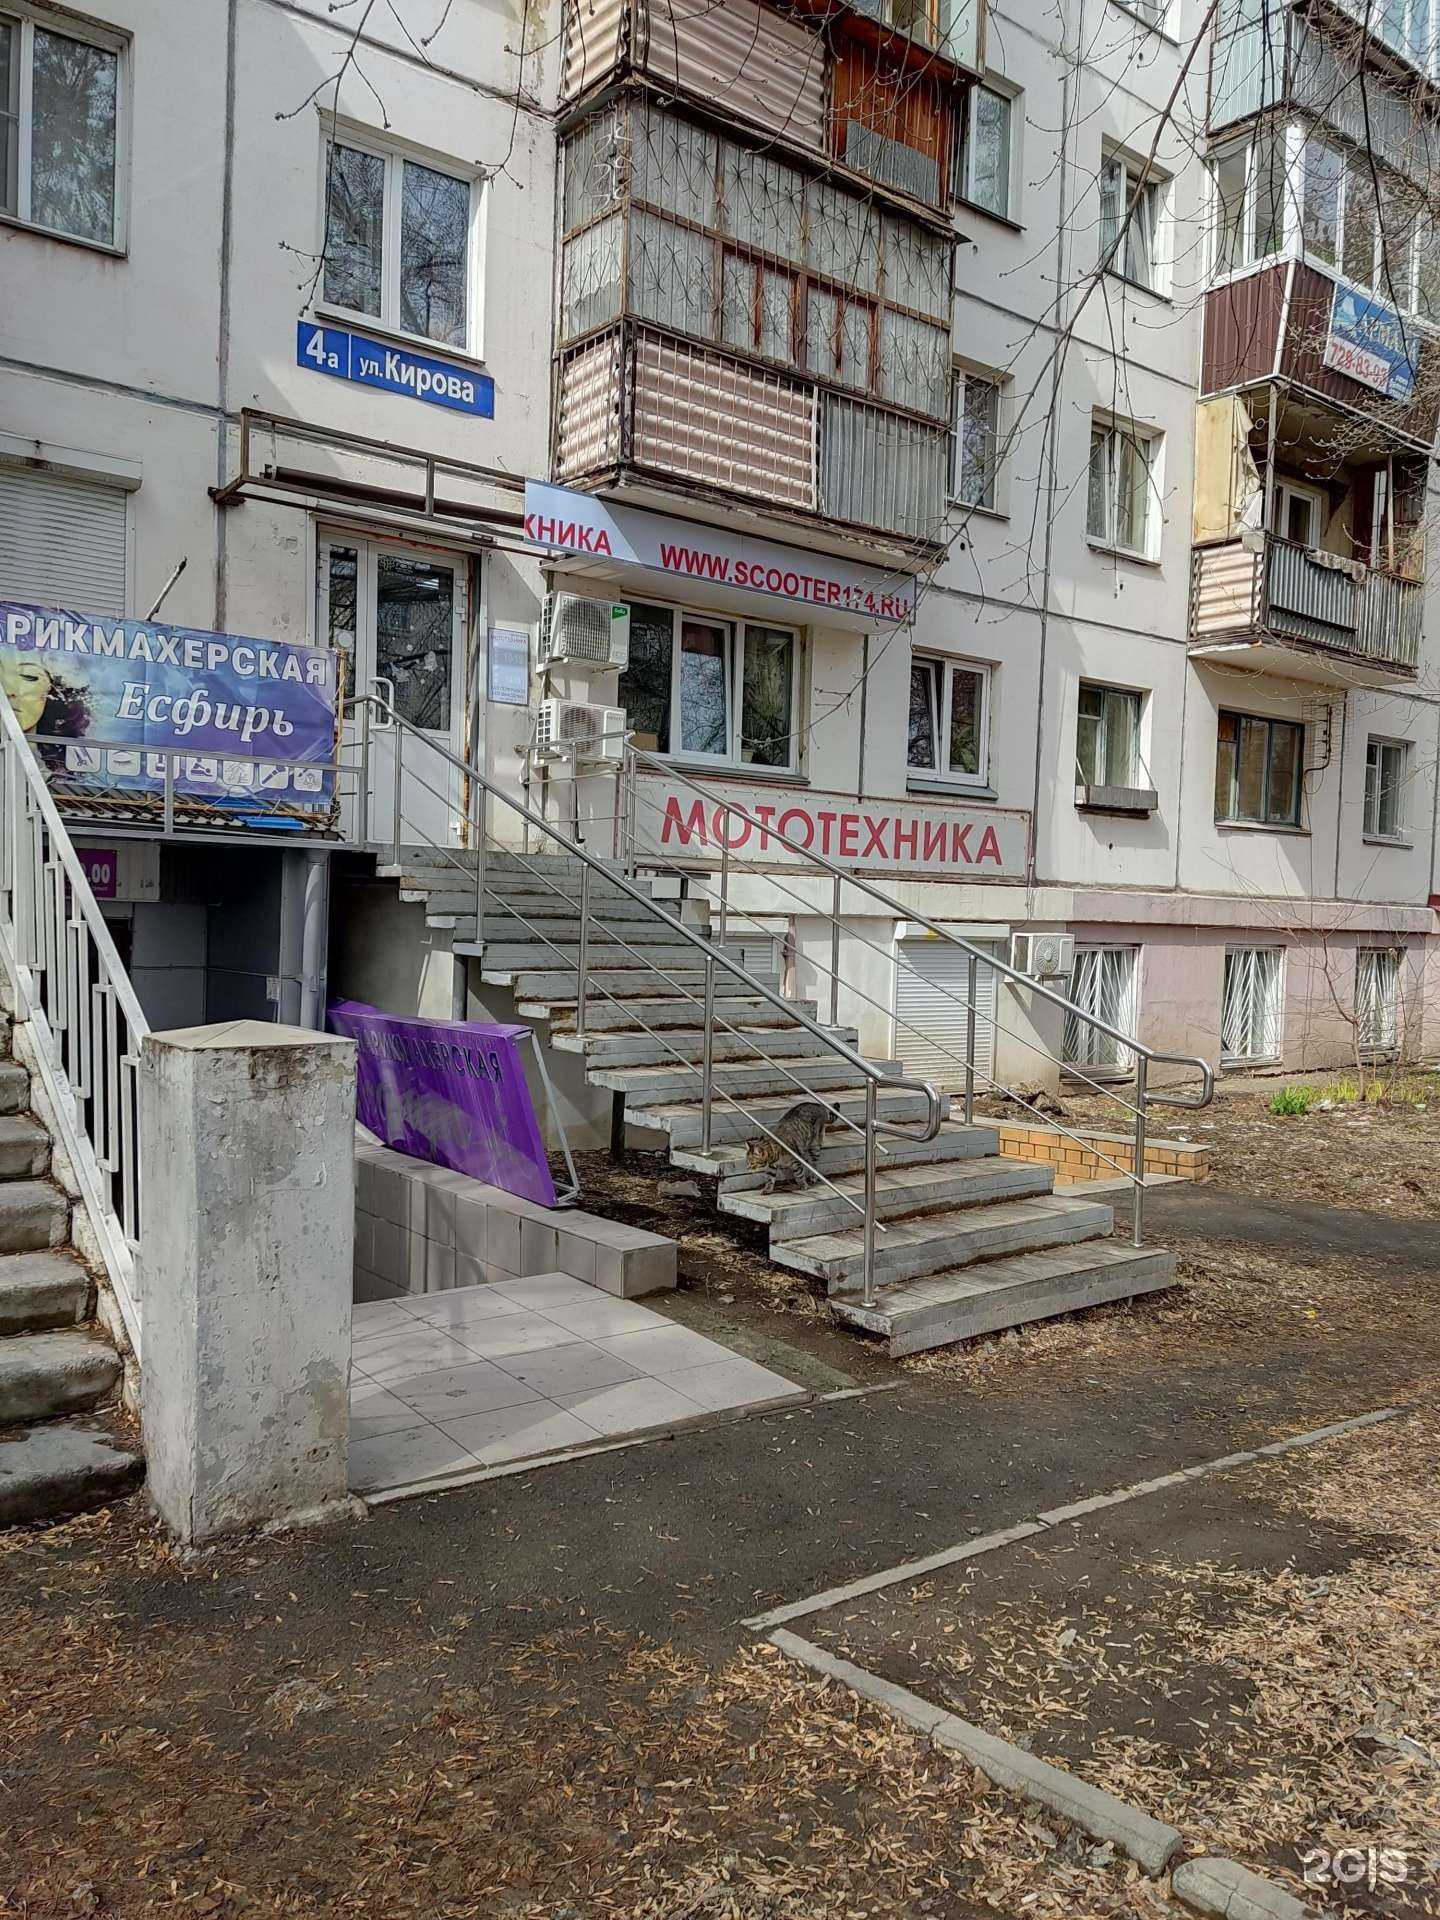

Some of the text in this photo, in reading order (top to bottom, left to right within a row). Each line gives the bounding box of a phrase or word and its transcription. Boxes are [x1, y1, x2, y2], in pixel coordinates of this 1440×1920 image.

[660, 543, 908, 619] WWW.SCOOTER174.RU
[0, 613, 327, 686] РИКМАХЕРСКАЯ
[115, 681, 295, 743] Есфирь
[661, 796, 1003, 866] МОТОТЕХНИКА
